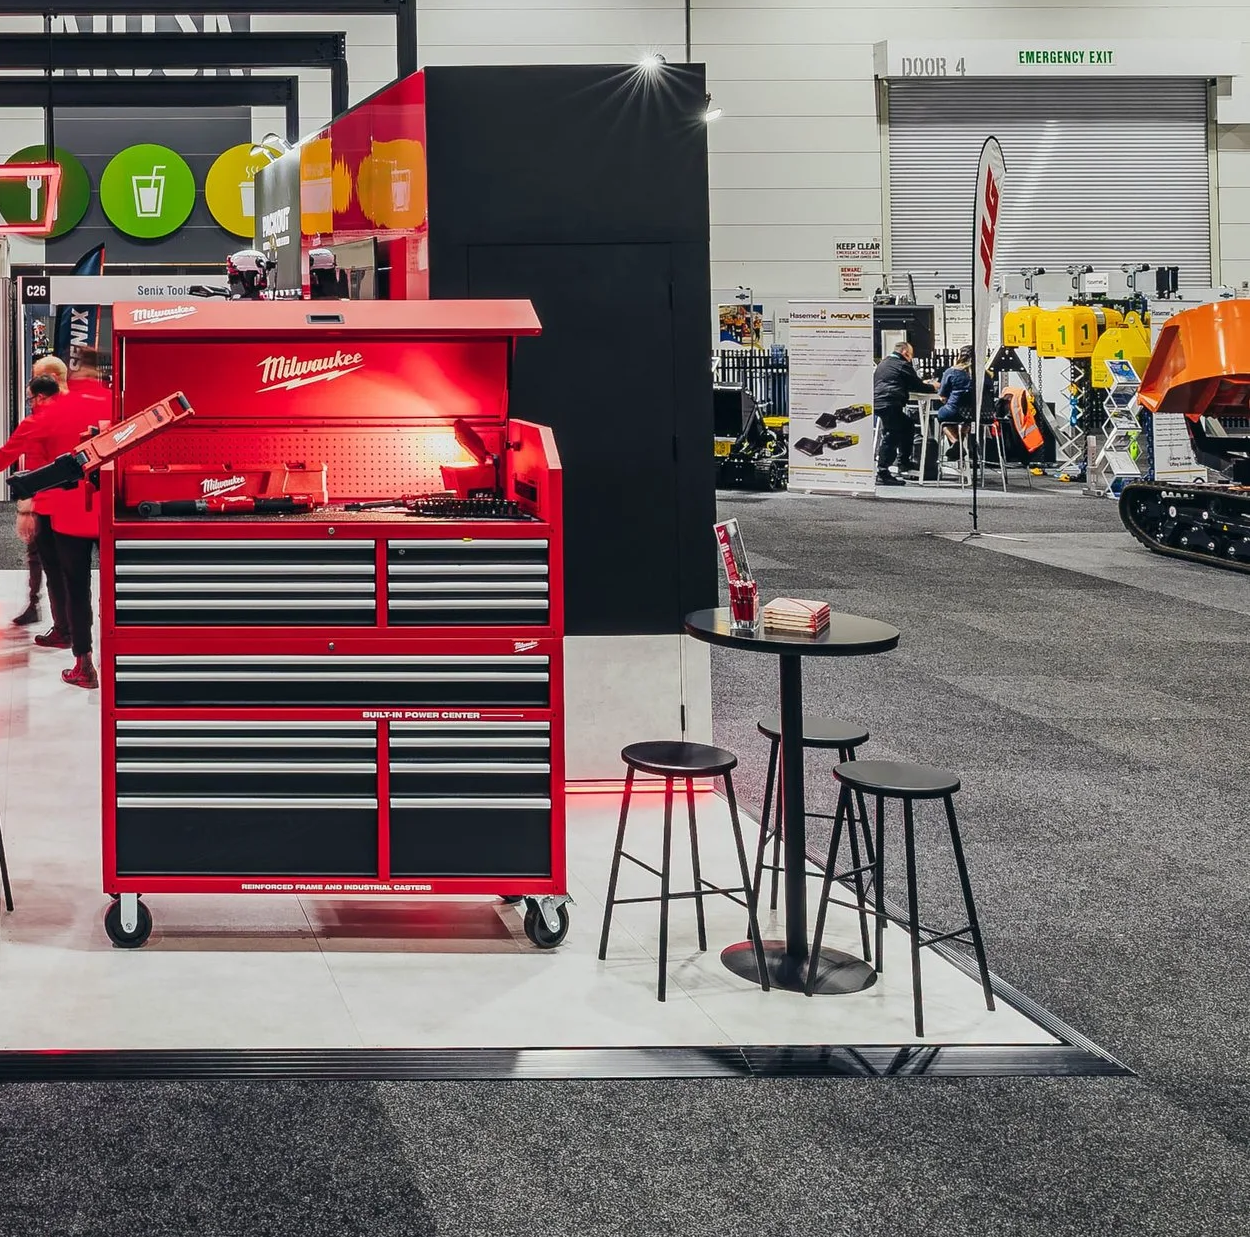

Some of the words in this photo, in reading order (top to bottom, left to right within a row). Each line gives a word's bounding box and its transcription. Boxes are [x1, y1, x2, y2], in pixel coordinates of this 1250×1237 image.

[1019, 51, 1085, 64] EMERGENCY
[1090, 51, 1113, 63] EXIT
[902, 58, 947, 76] DOOR
[956, 58, 966, 76] 4
[980, 163, 999, 293] JLG
[26, 285, 47, 297] C26
[137, 285, 164, 296] Senix
[168, 285, 190, 296] Tools
[129, 305, 196, 321] Milwaukee
[830, 313, 871, 321] MOVEX
[1019, 324, 1026, 338] 1
[1058, 325, 1066, 345] 1
[1081, 324, 1089, 340] 1
[257, 350, 363, 384] Milwaukee
[200, 475, 246, 494] Milwaukee
[405, 711, 439, 719] POWER
